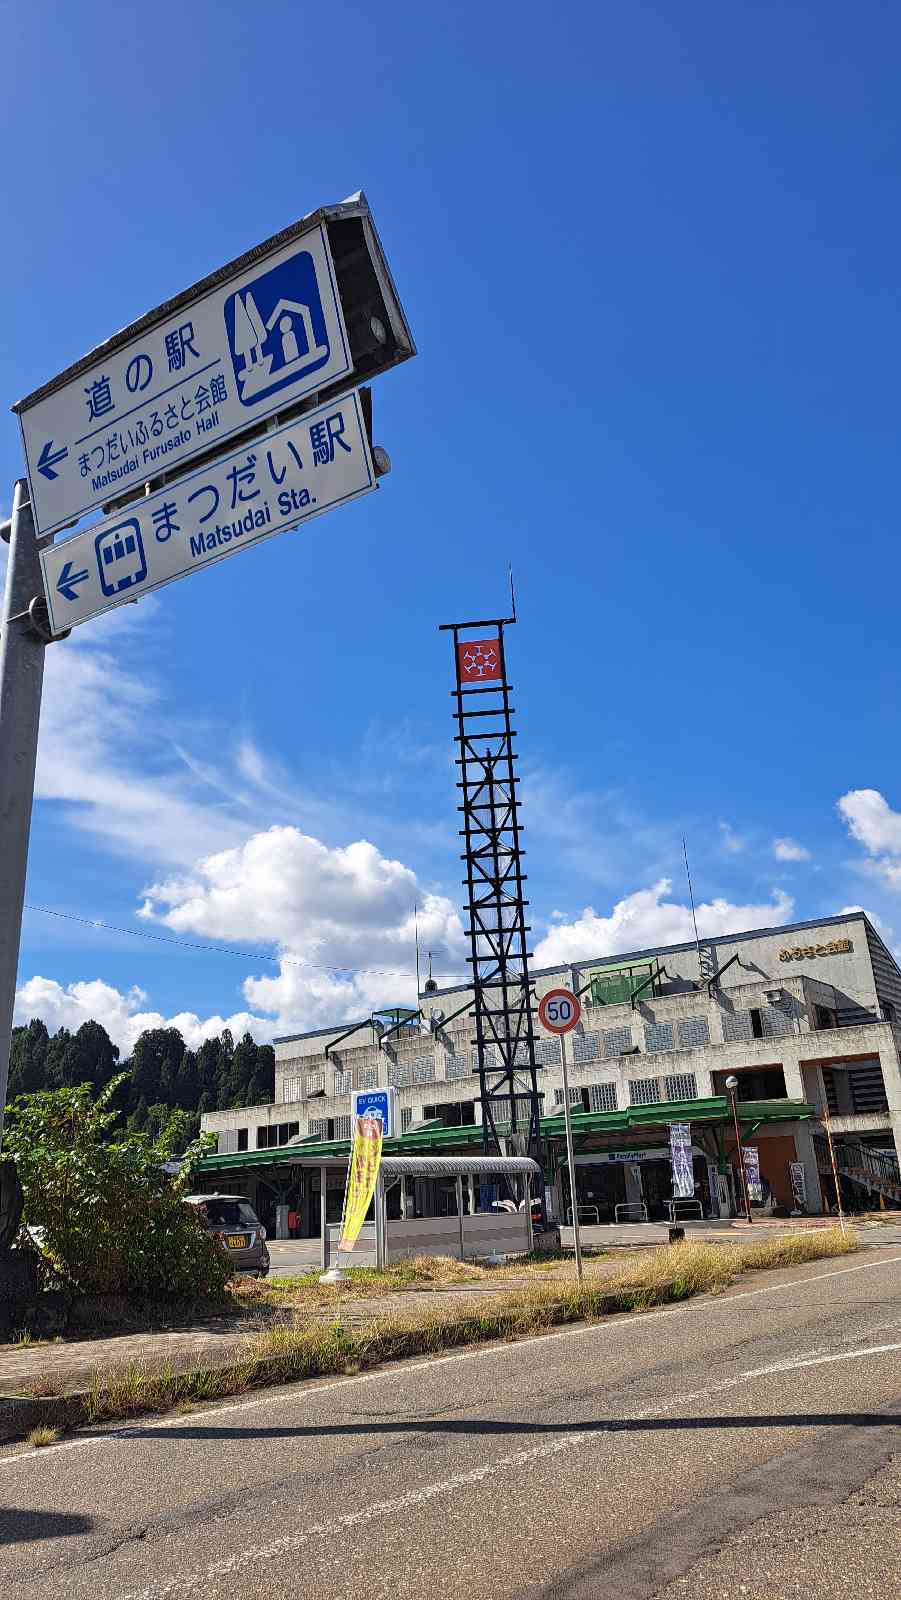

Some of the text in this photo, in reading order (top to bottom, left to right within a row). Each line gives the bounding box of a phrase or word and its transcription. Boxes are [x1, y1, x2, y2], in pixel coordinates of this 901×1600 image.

[83, 321, 200, 422] 道の駅
[78, 373, 228, 477] まつだいふるさと会館
[91, 412, 219, 492] Matsudai Furusato Hall
[151, 412, 352, 542] まつだい駅
[189, 488, 317, 558] Matsudai Sta.
[548, 1001, 570, 1020] 50
